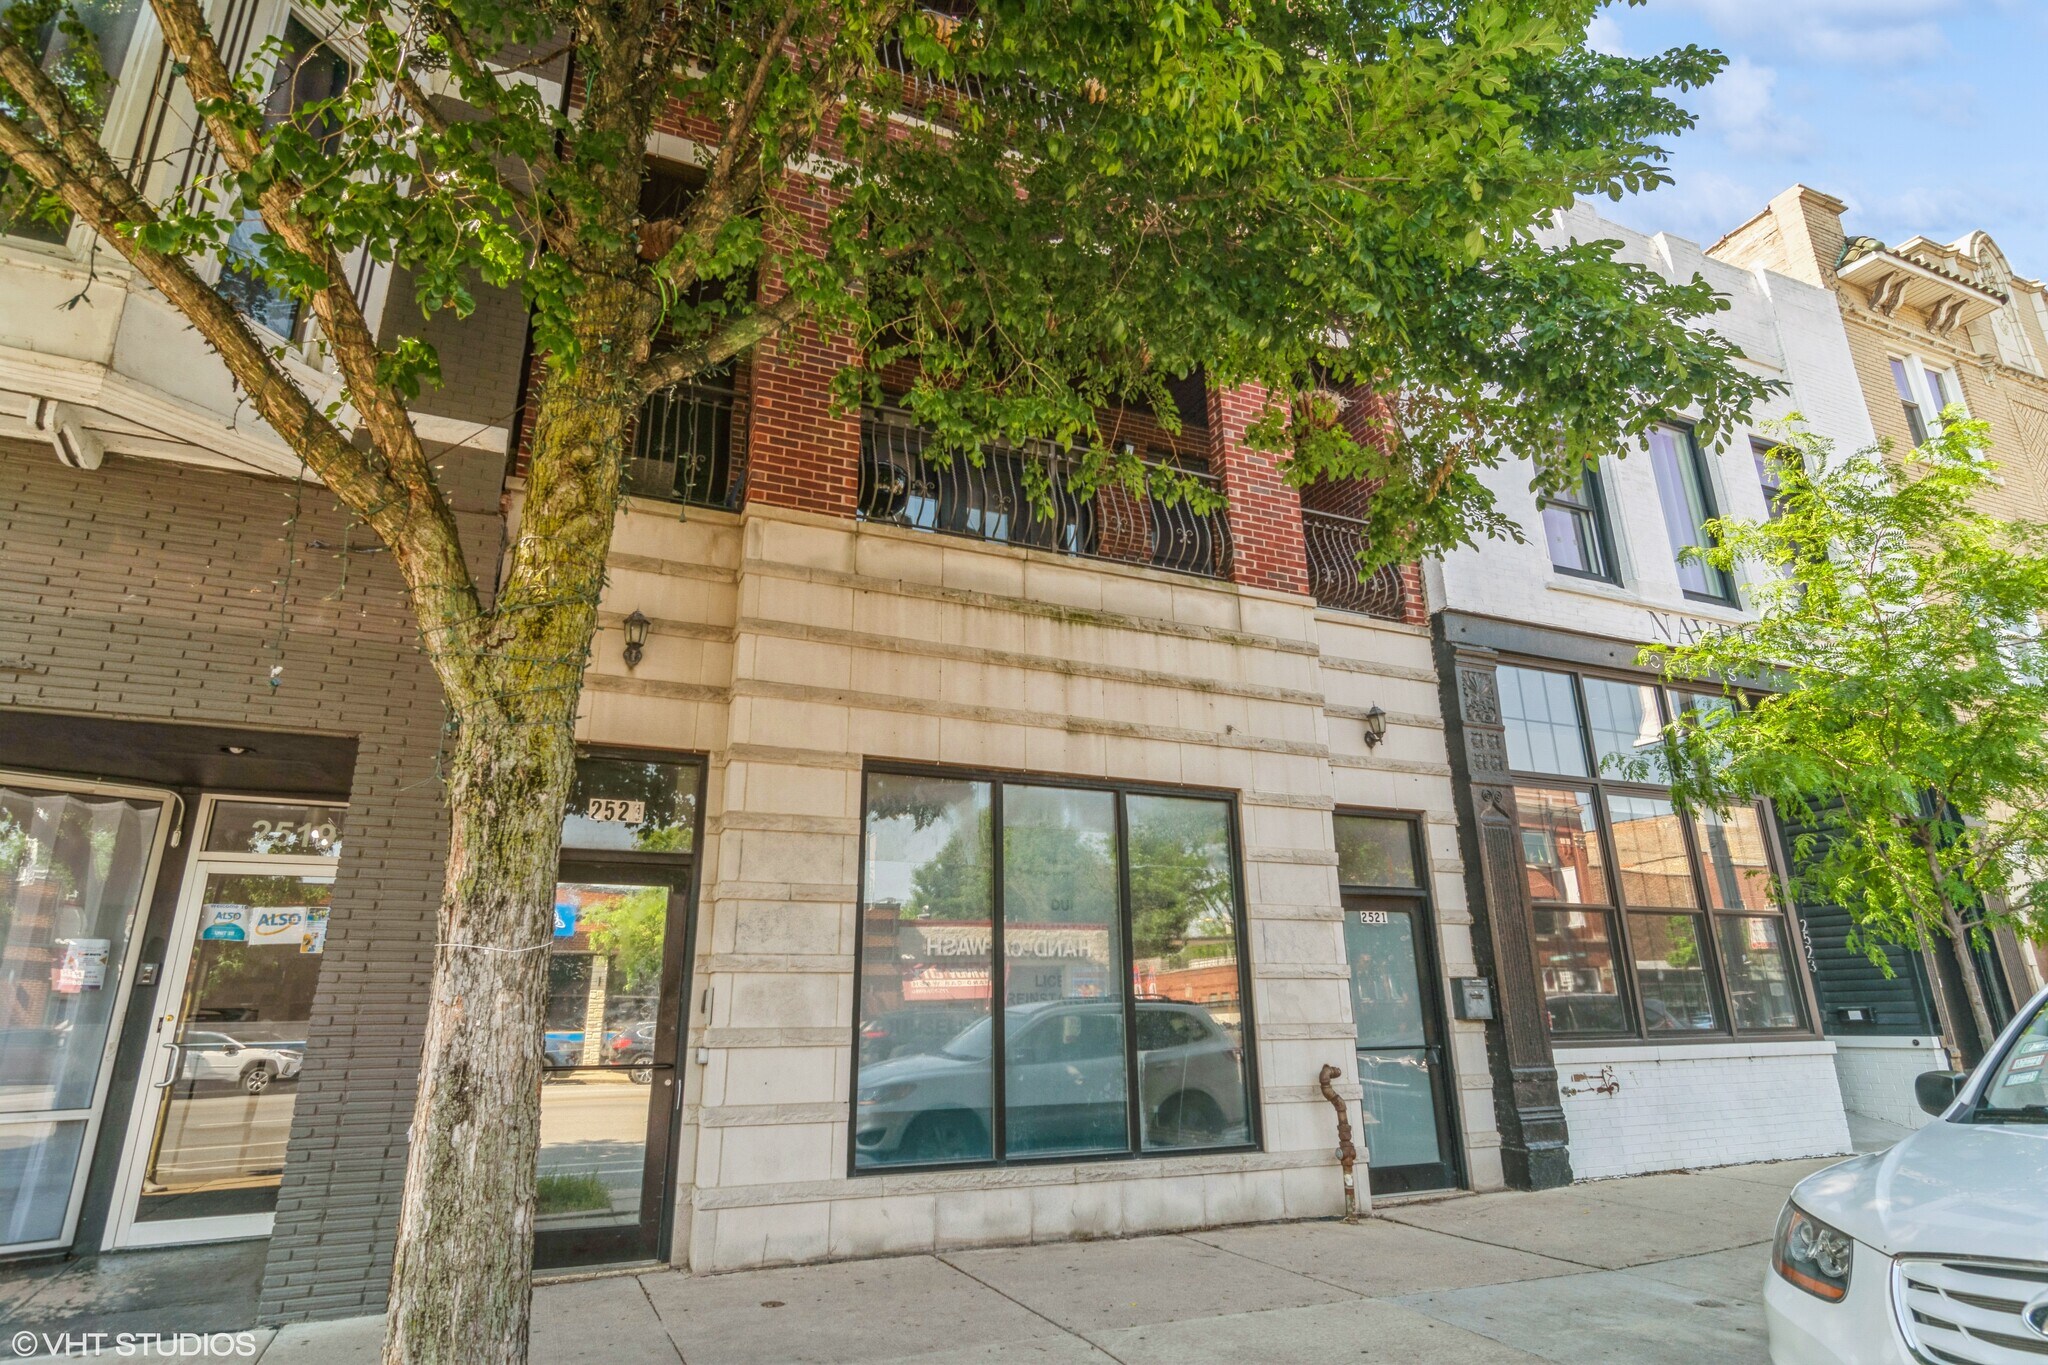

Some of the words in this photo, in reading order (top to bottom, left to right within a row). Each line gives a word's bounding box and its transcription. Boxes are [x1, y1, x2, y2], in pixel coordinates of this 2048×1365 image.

[248, 820, 337, 849] 2519
[215, 911, 242, 920] ALSO
[257, 913, 301, 926] ALSO
[1361, 912, 1386, 922] 2521
[1800, 919, 1817, 973] 2523
